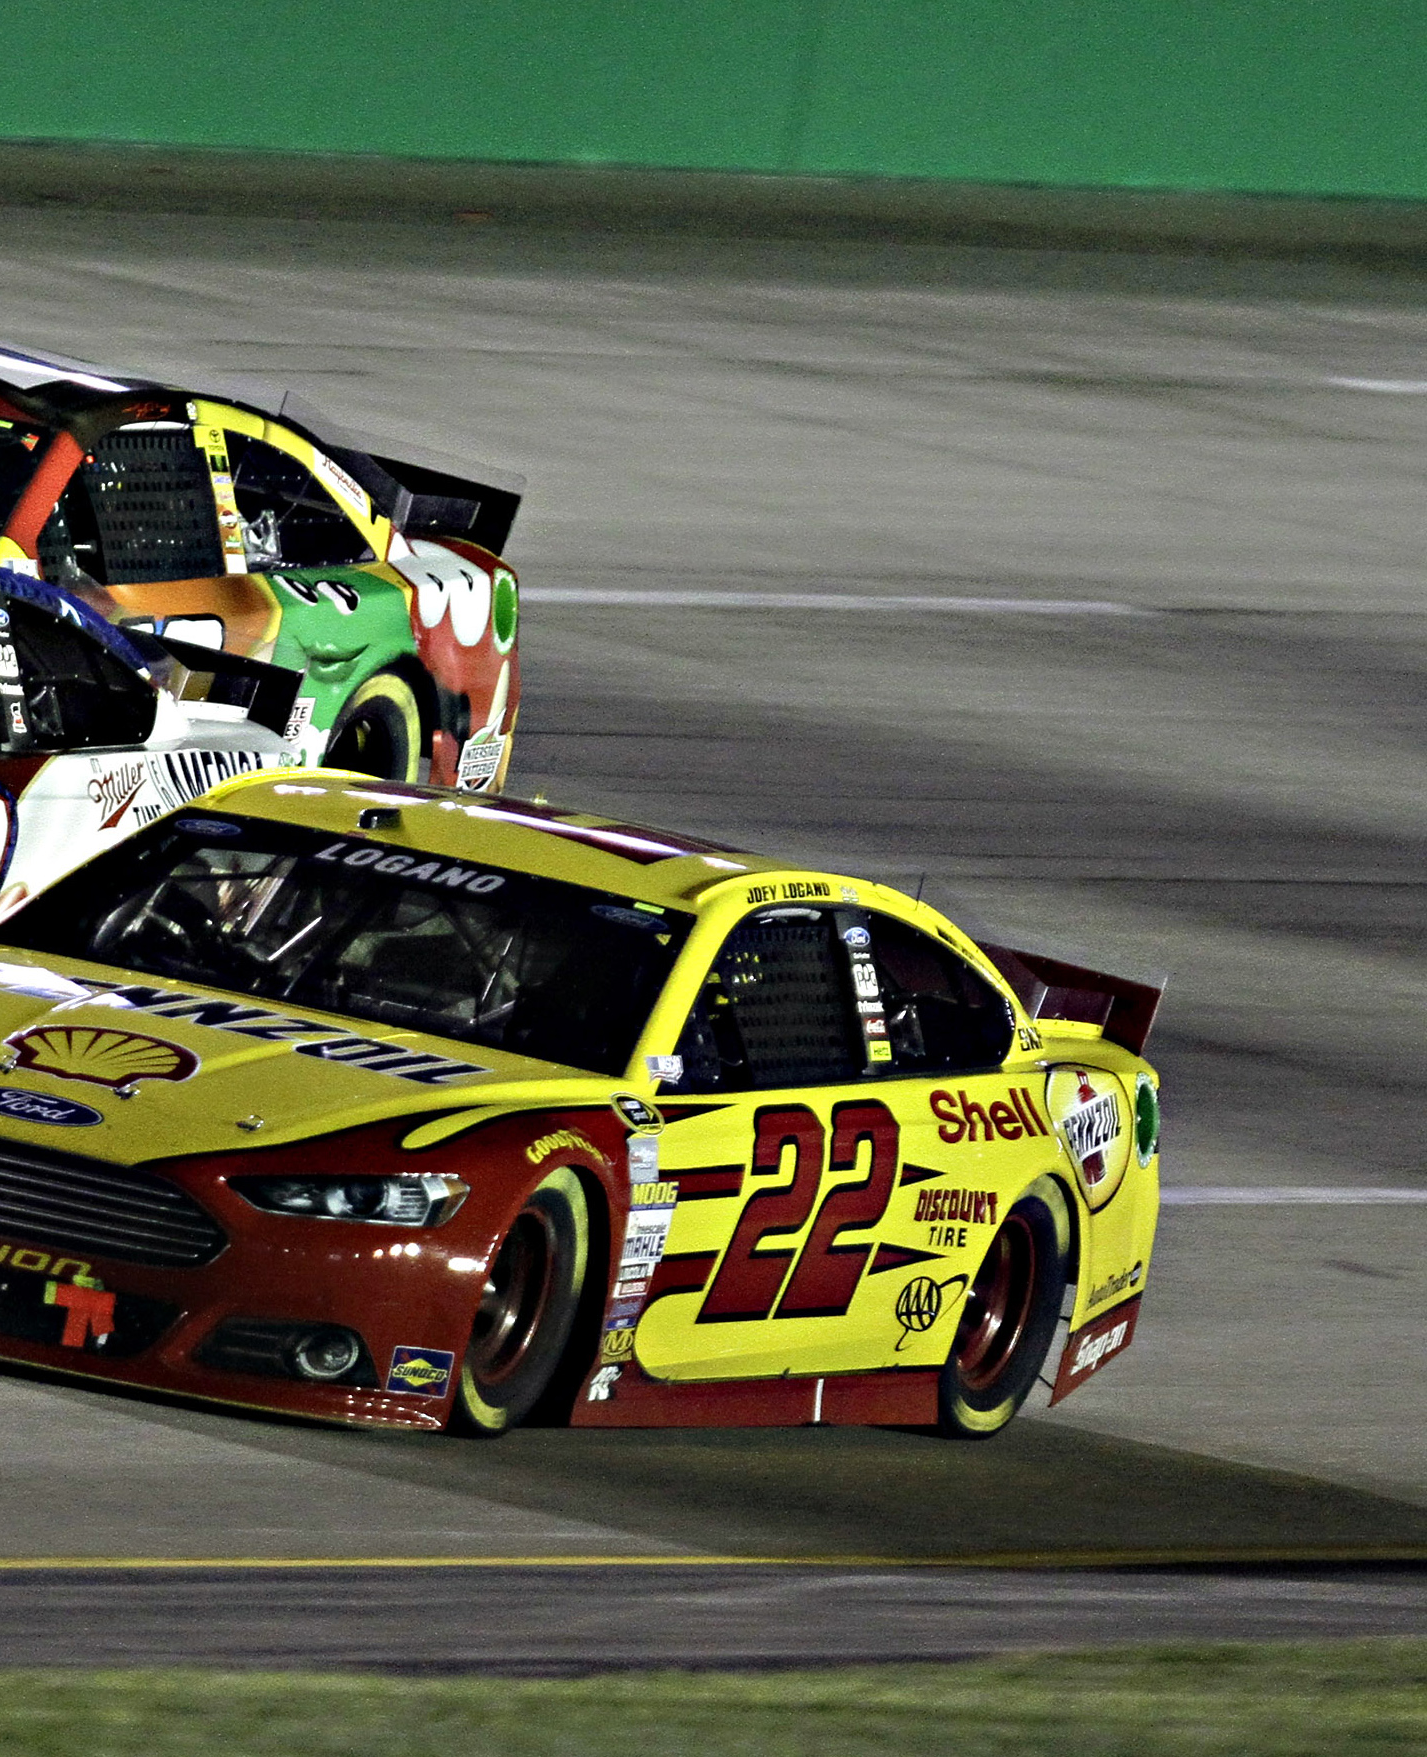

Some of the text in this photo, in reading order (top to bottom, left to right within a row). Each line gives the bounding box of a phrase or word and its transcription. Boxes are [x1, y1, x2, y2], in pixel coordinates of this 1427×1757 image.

[88, 762, 144, 821] Miller
[315, 842, 506, 894] LOGANO
[747, 882, 830, 904] JOEY LOGANO
[929, 1087, 1050, 1144] Shell
[632, 1181, 679, 1205] MOOG
[695, 1098, 901, 1324] 22
[914, 1188, 998, 1225] DISCOUNT
[929, 1226, 968, 1248] TIRE
[395, 1364, 446, 1383] SUNOCO
